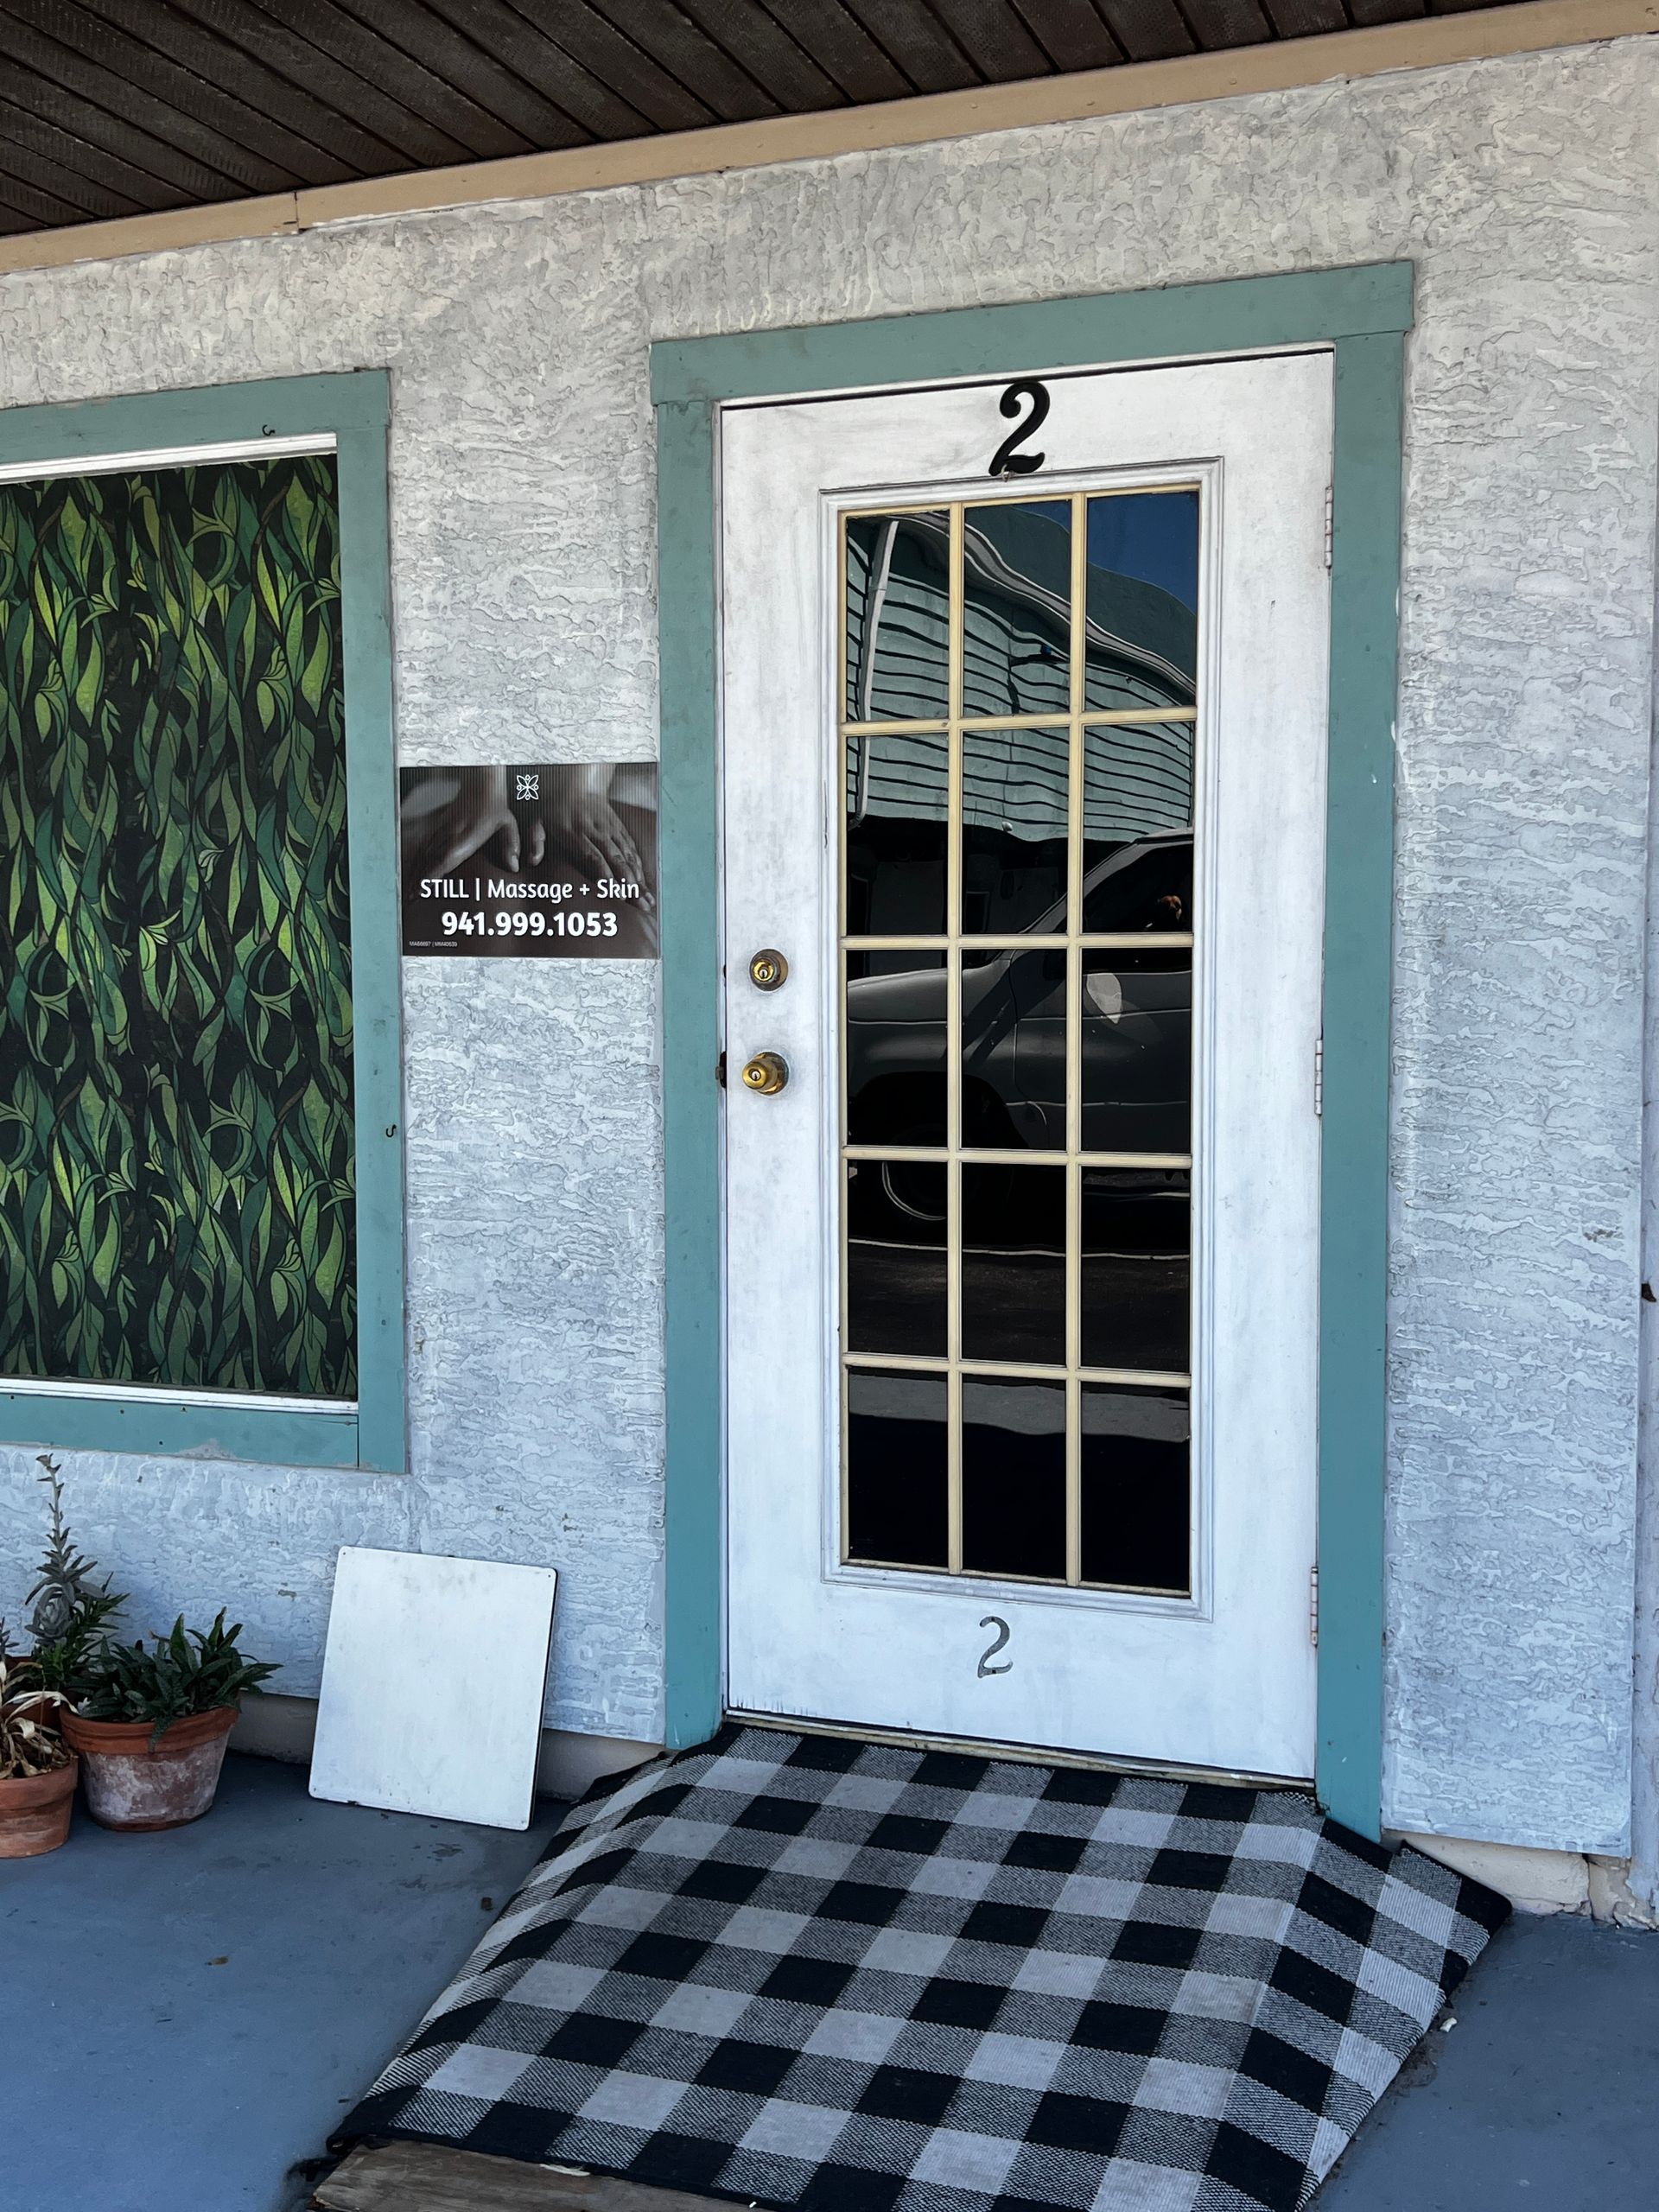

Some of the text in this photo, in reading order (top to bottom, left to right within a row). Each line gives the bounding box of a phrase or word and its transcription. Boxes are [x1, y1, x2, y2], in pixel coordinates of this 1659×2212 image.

[988, 380, 1050, 476] 2
[420, 879, 469, 898] STILL
[487, 879, 573, 903] Massage
[596, 878, 639, 899] Skin
[442, 912, 618, 937] 941.999.1053
[977, 1616, 1014, 1678] 2
